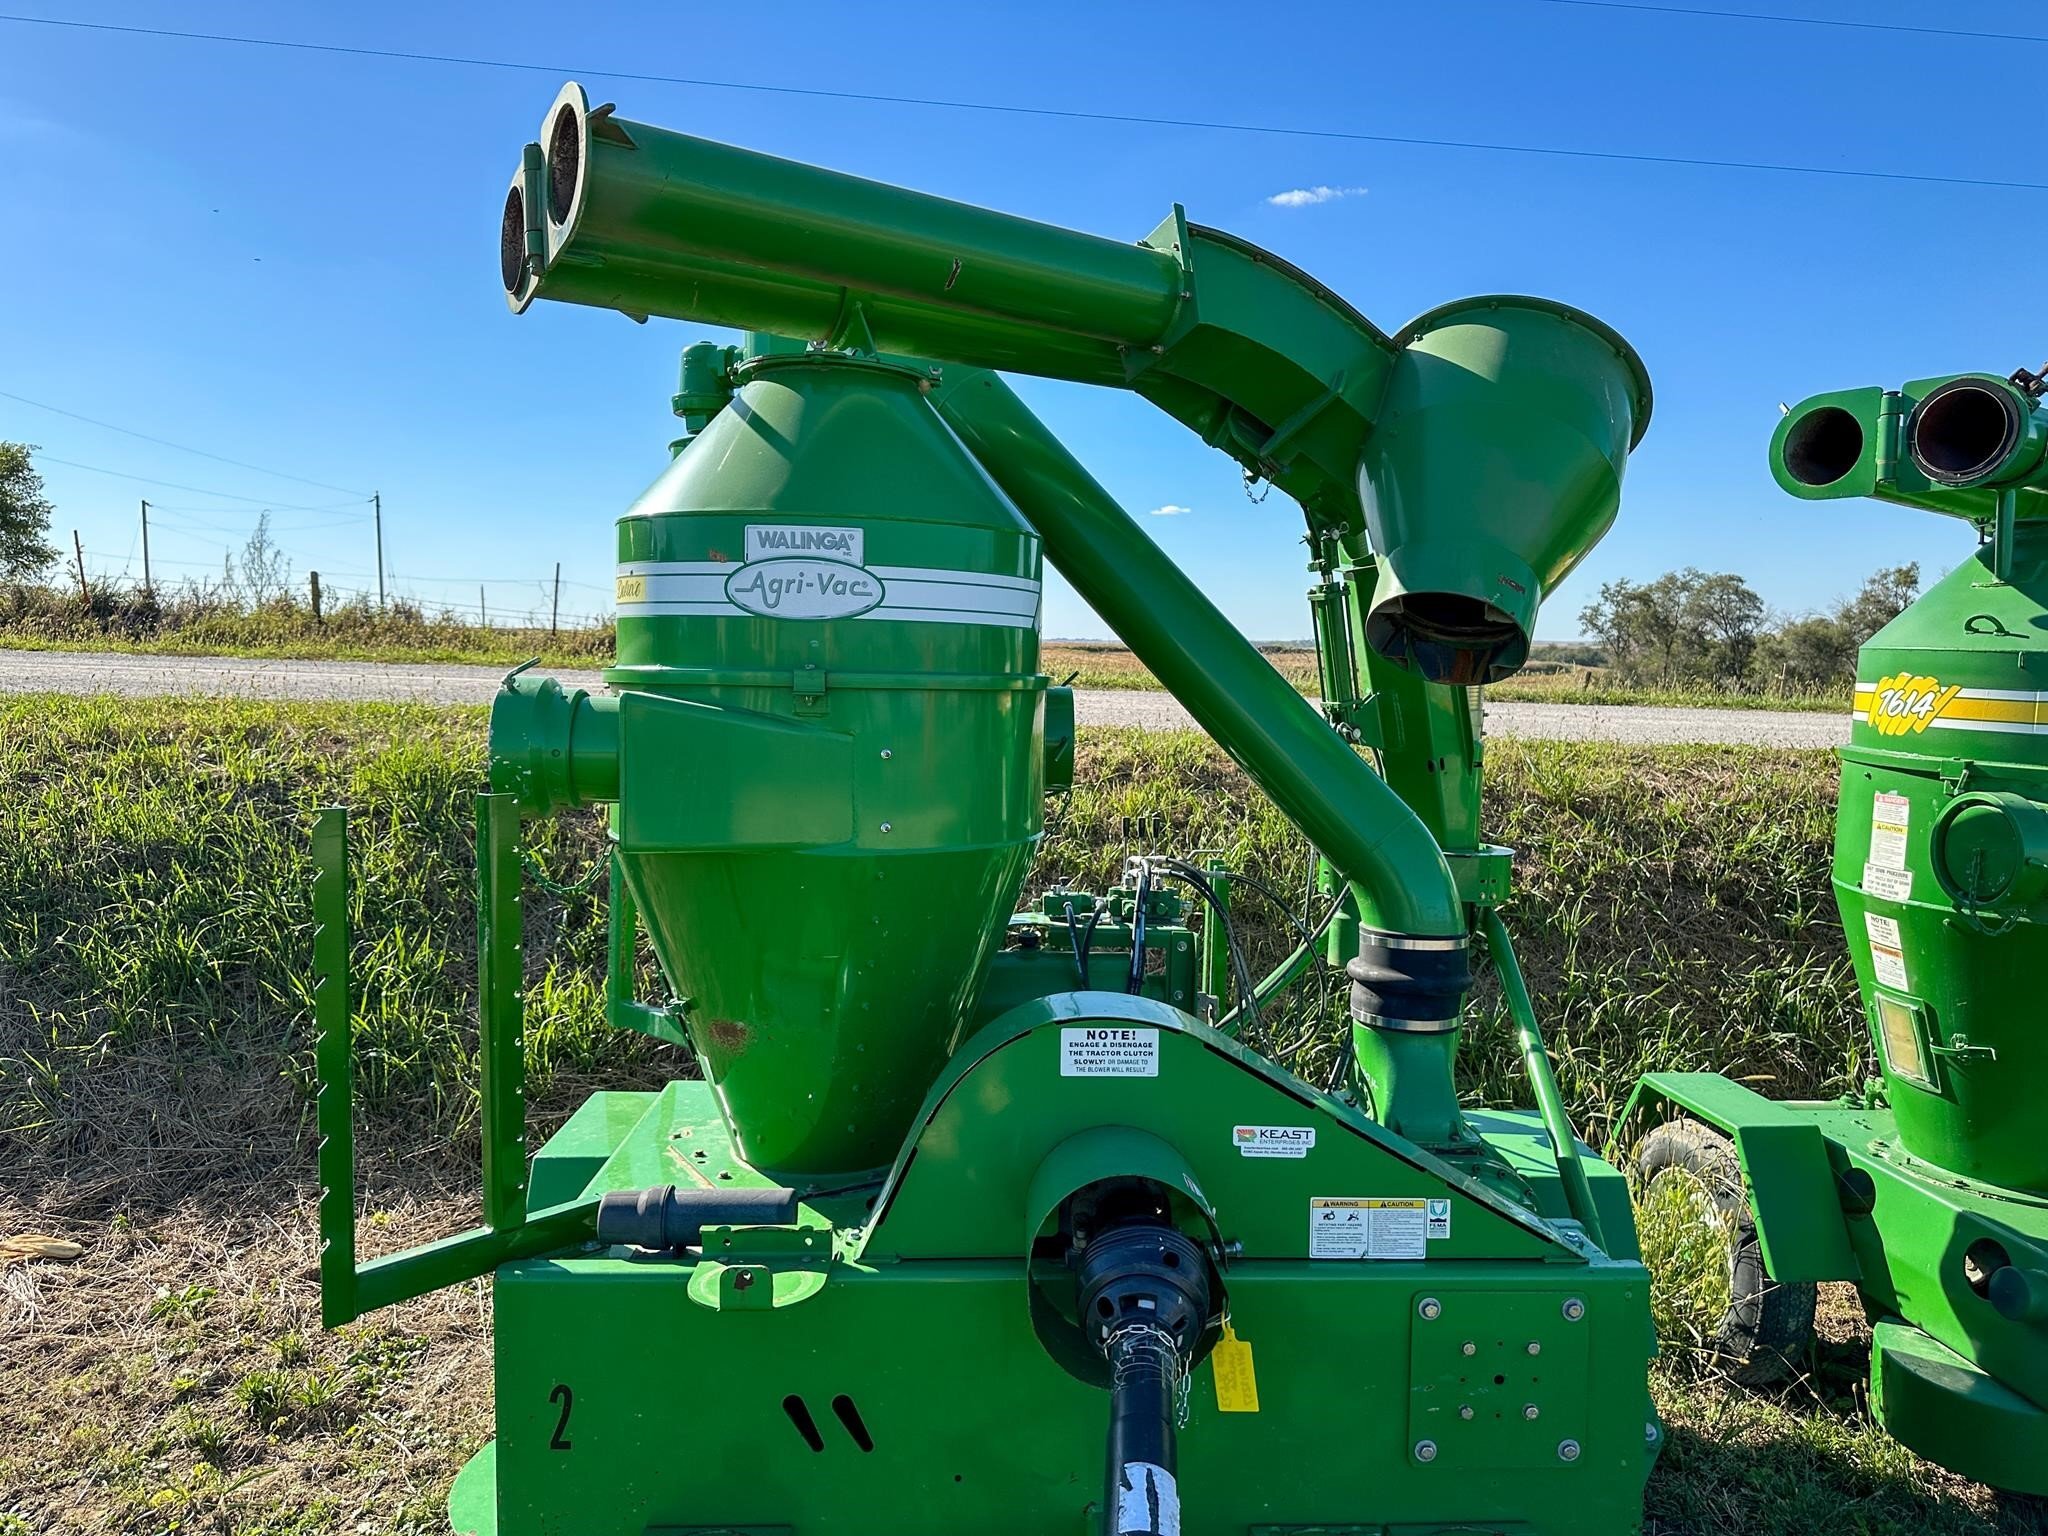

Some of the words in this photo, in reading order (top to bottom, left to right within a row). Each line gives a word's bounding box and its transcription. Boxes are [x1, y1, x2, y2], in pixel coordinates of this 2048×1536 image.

[1881, 824, 1903, 833] CAUTION
[1086, 1030, 1136, 1040] NOTE!
[1260, 1129, 1312, 1140] KEAST
[549, 1384, 573, 1450] 2
